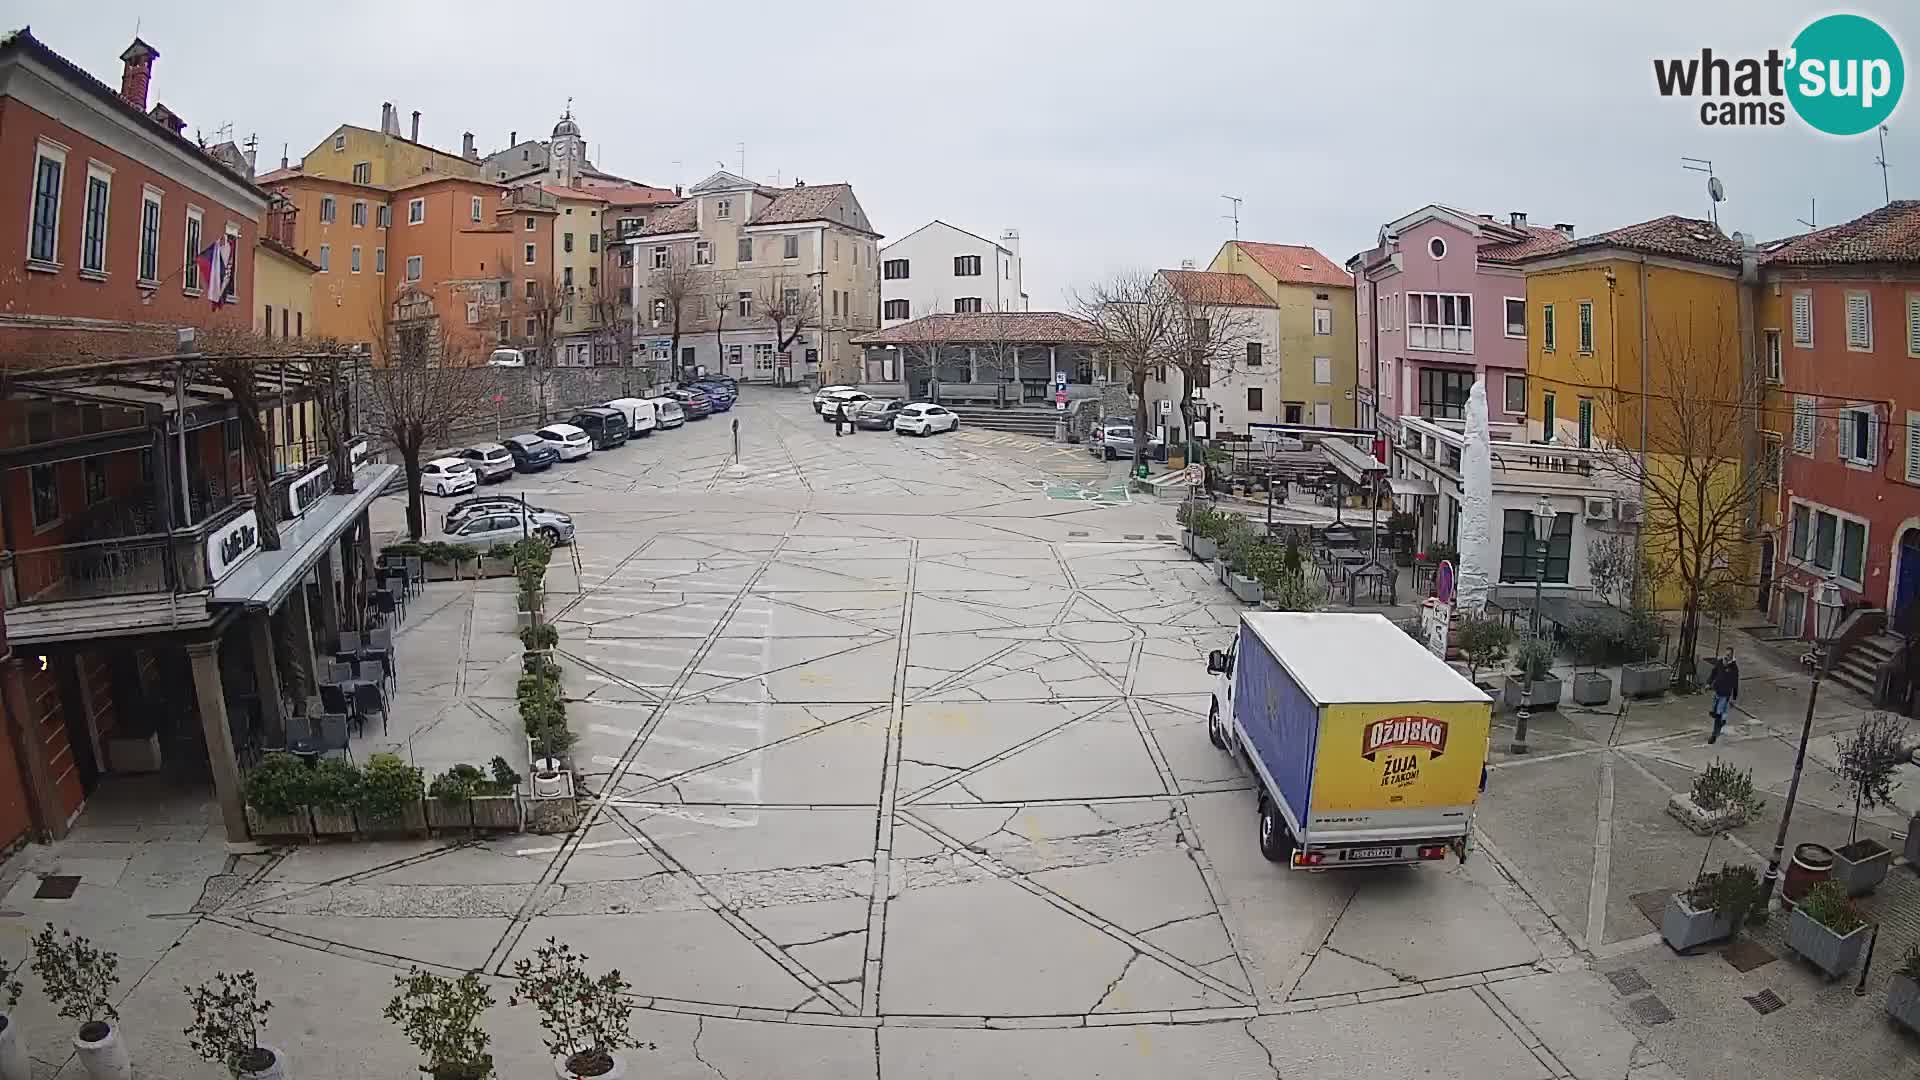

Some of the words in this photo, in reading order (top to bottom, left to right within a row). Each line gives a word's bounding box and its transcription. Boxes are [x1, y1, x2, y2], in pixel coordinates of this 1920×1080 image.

[1370, 717, 1442, 749] Ožujsko
[1384, 754, 1417, 777] ŽUJA
[1381, 776, 1389, 787] JE
